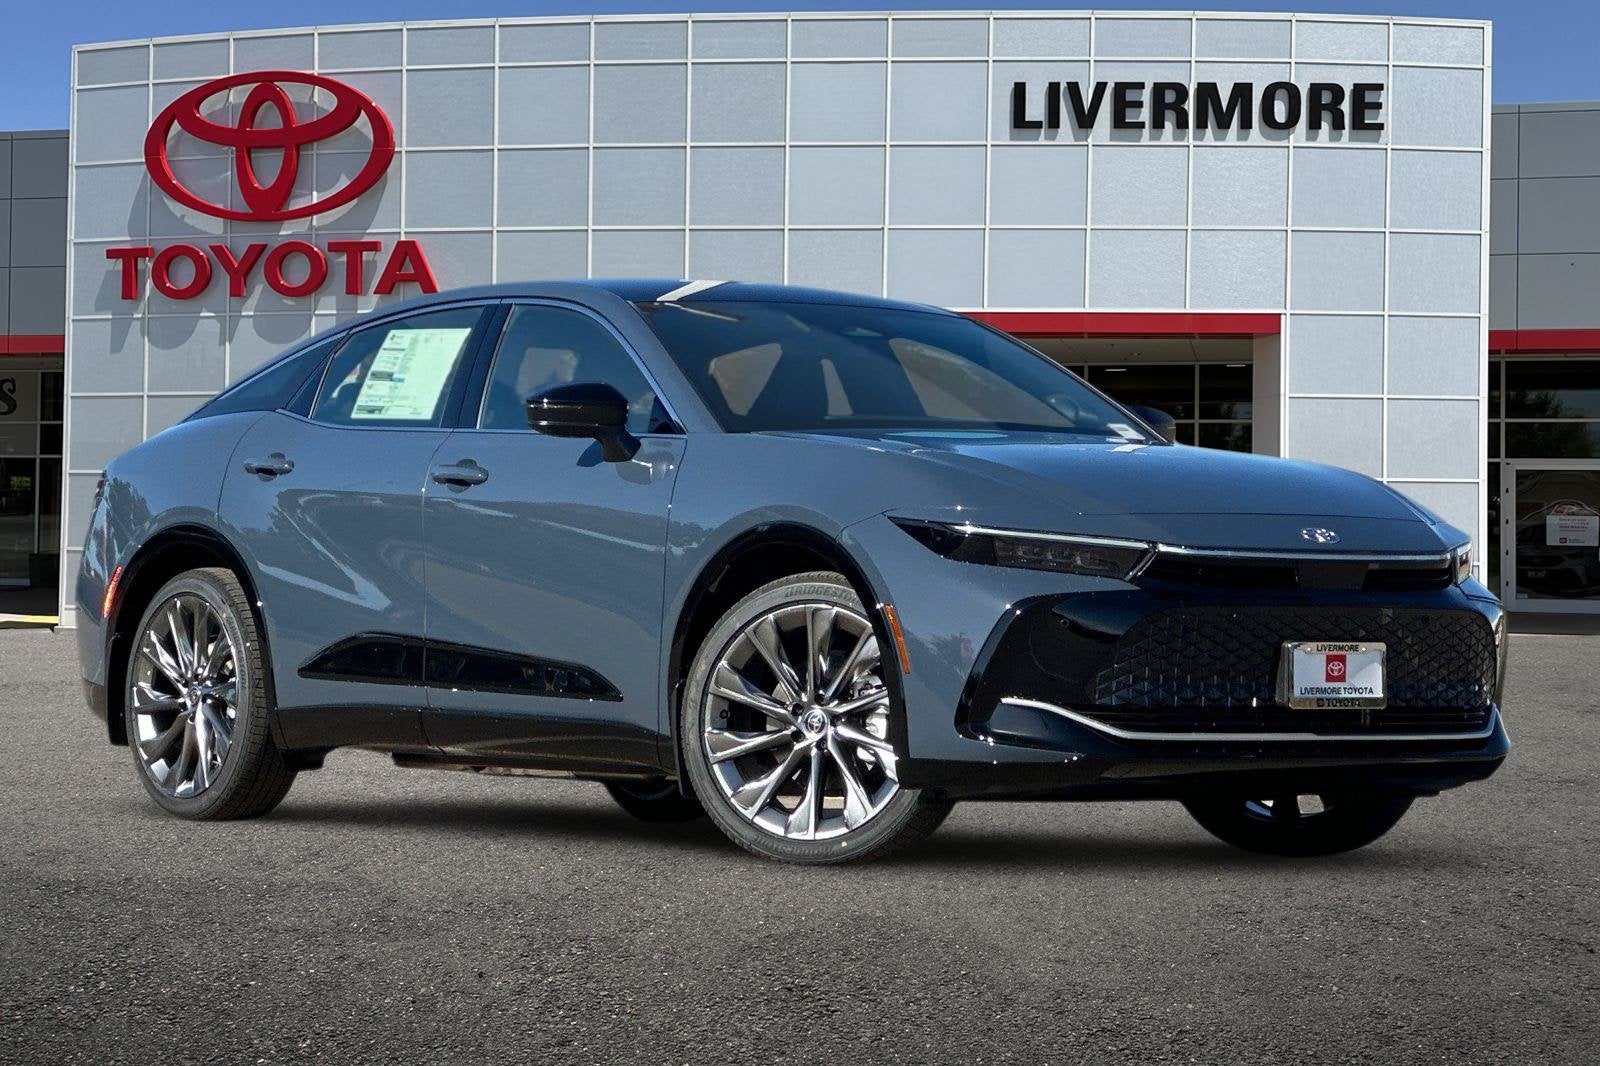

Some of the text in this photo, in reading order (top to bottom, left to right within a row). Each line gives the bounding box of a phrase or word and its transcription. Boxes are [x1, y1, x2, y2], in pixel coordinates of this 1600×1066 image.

[1013, 81, 1385, 131] LIVERMORE
[106, 240, 440, 300] TOYOTA
[1316, 644, 1360, 652] LIVERMORE
[1300, 687, 1374, 695] LIVERMORE TOYOTA
[1326, 698, 1360, 707] TOYOTA
